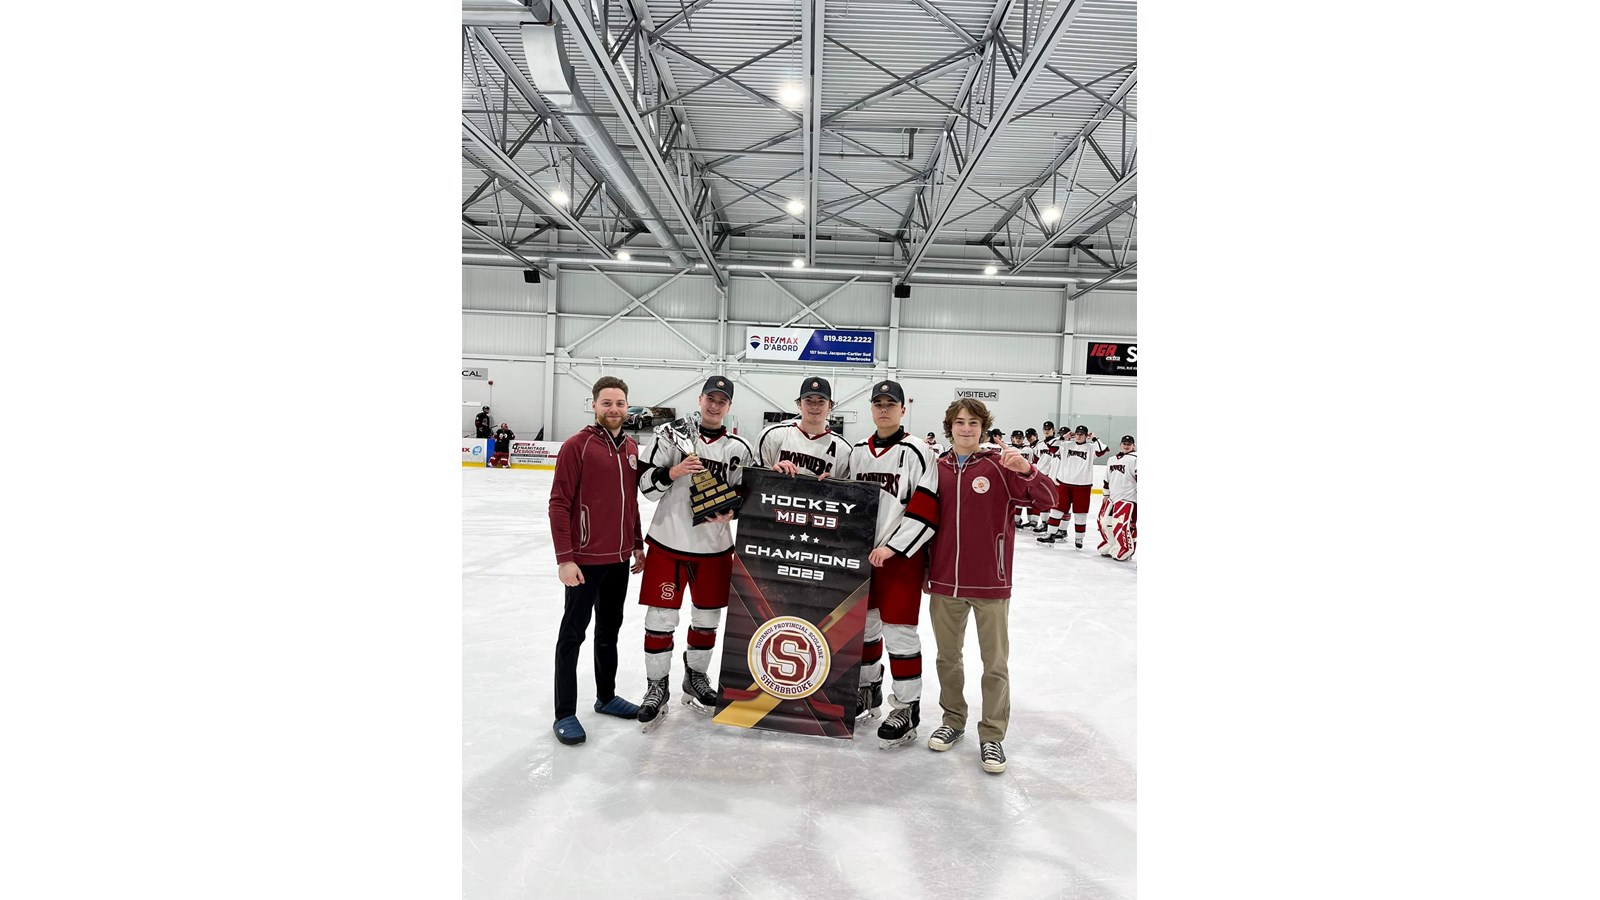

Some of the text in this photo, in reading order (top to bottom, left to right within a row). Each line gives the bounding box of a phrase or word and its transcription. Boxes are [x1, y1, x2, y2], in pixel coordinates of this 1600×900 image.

[764, 336, 798, 345] RE/MAX
[823, 335, 872, 343] 819.822.2222
[764, 344, 798, 352] D'ABORD
[1090, 344, 1117, 357] IGA
[826, 441, 836, 457] A
[730, 456, 740, 471] C
[760, 493, 857, 514] HOCKEY
[776, 511, 837, 528] M18 D3
[745, 544, 861, 570] CHAMPIONS
[777, 565, 824, 581] 2023
[755, 622, 824, 659] TOURNOI PROVINCIAL SCOLAIRE
[768, 631, 811, 685] S
[760, 674, 814, 695] SHERBROOKE
